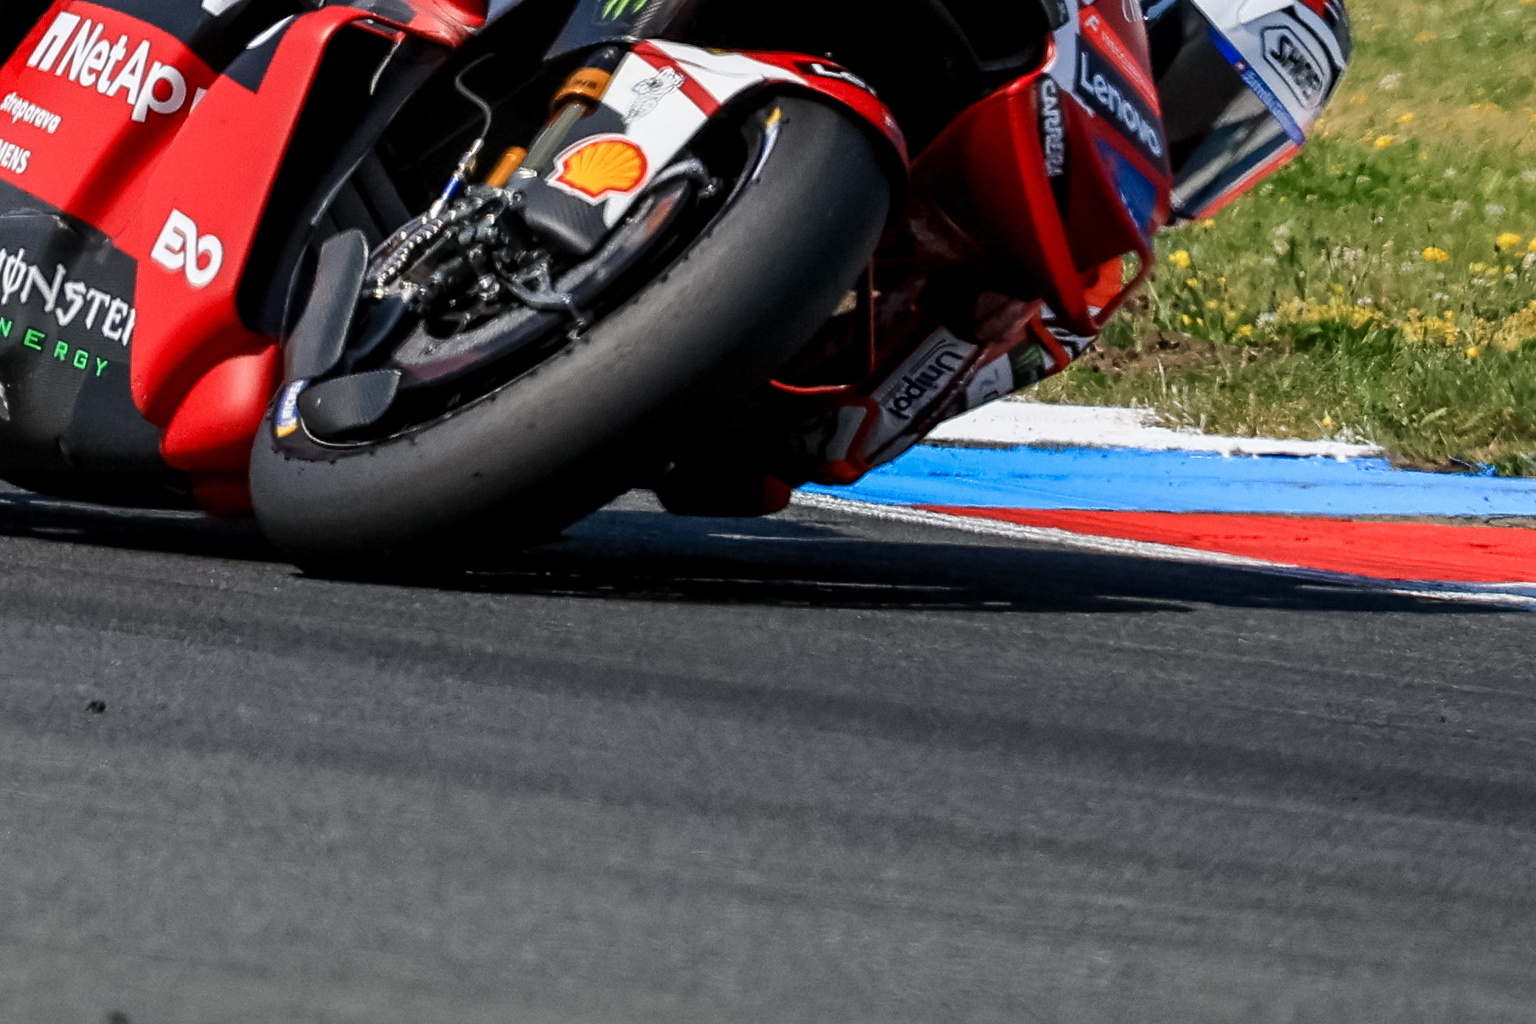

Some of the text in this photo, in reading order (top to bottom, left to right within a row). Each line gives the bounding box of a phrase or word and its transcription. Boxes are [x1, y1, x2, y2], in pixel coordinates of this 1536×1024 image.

[0, 91, 62, 134] streparava
[53, 18, 207, 123] NetAp
[1081, 51, 1162, 158] Lenovo
[887, 349, 965, 421] Unipol
